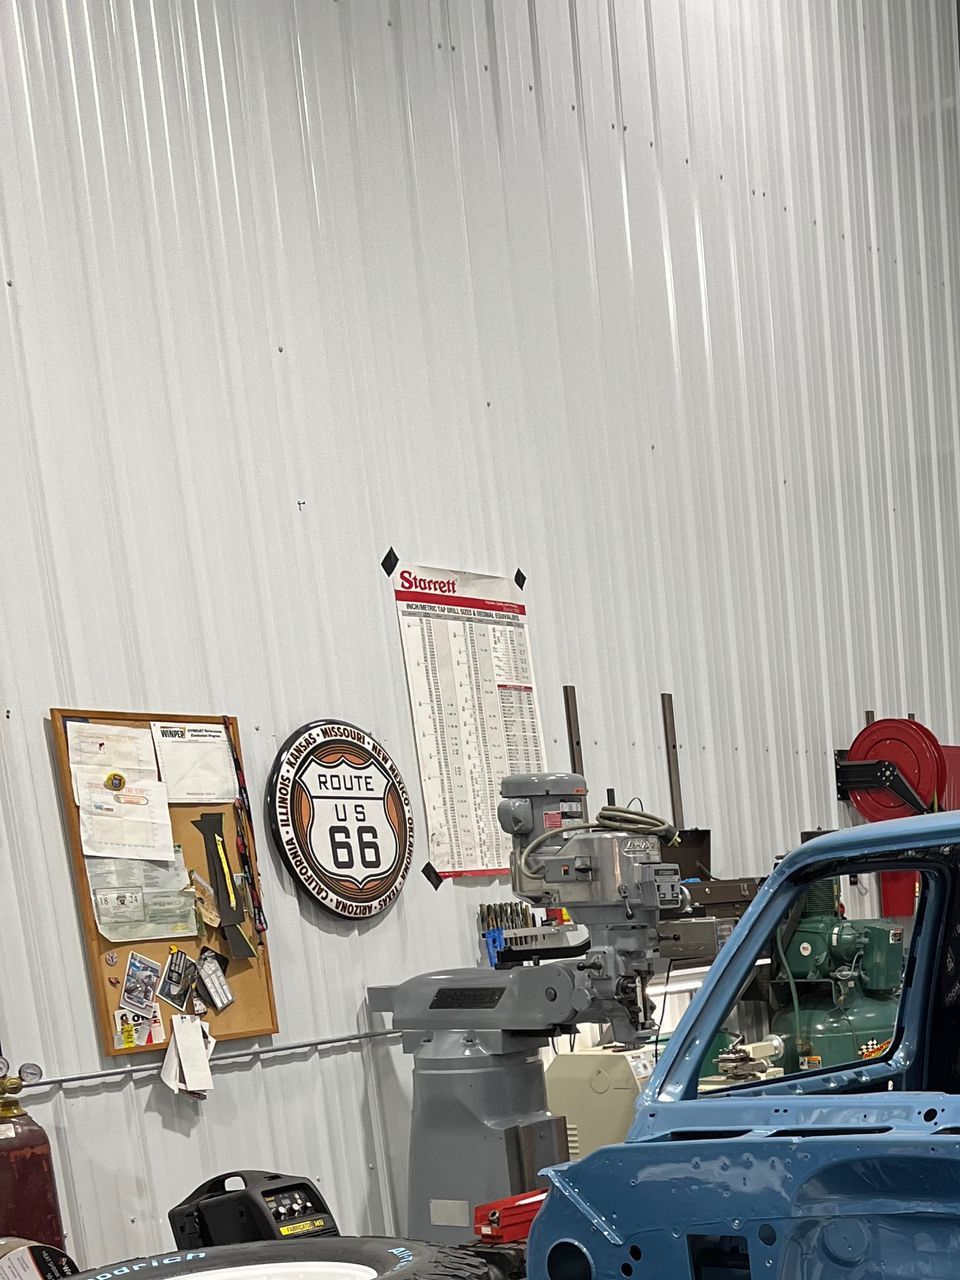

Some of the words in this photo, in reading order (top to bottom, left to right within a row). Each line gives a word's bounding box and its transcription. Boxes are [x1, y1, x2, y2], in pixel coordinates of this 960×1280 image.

[400, 570, 457, 594] Starrett
[460, 608, 472, 616] SIZES
[320, 726, 366, 746] MISSOURI
[286, 732, 317, 769] KANSAS
[317, 773, 375, 792] ROUTE
[371, 742, 389, 764] NEW
[388, 762, 410, 807] MEXICO
[278, 774, 291, 832] ILLINOIS
[334, 803, 366, 822] US
[328, 825, 382, 869] 66
[399, 816, 414, 881] OKLAHOMA
[285, 837, 329, 901] CALIFORNIA
[335, 898, 373, 917] ARIZONA
[378, 888, 399, 911] TEXAS
